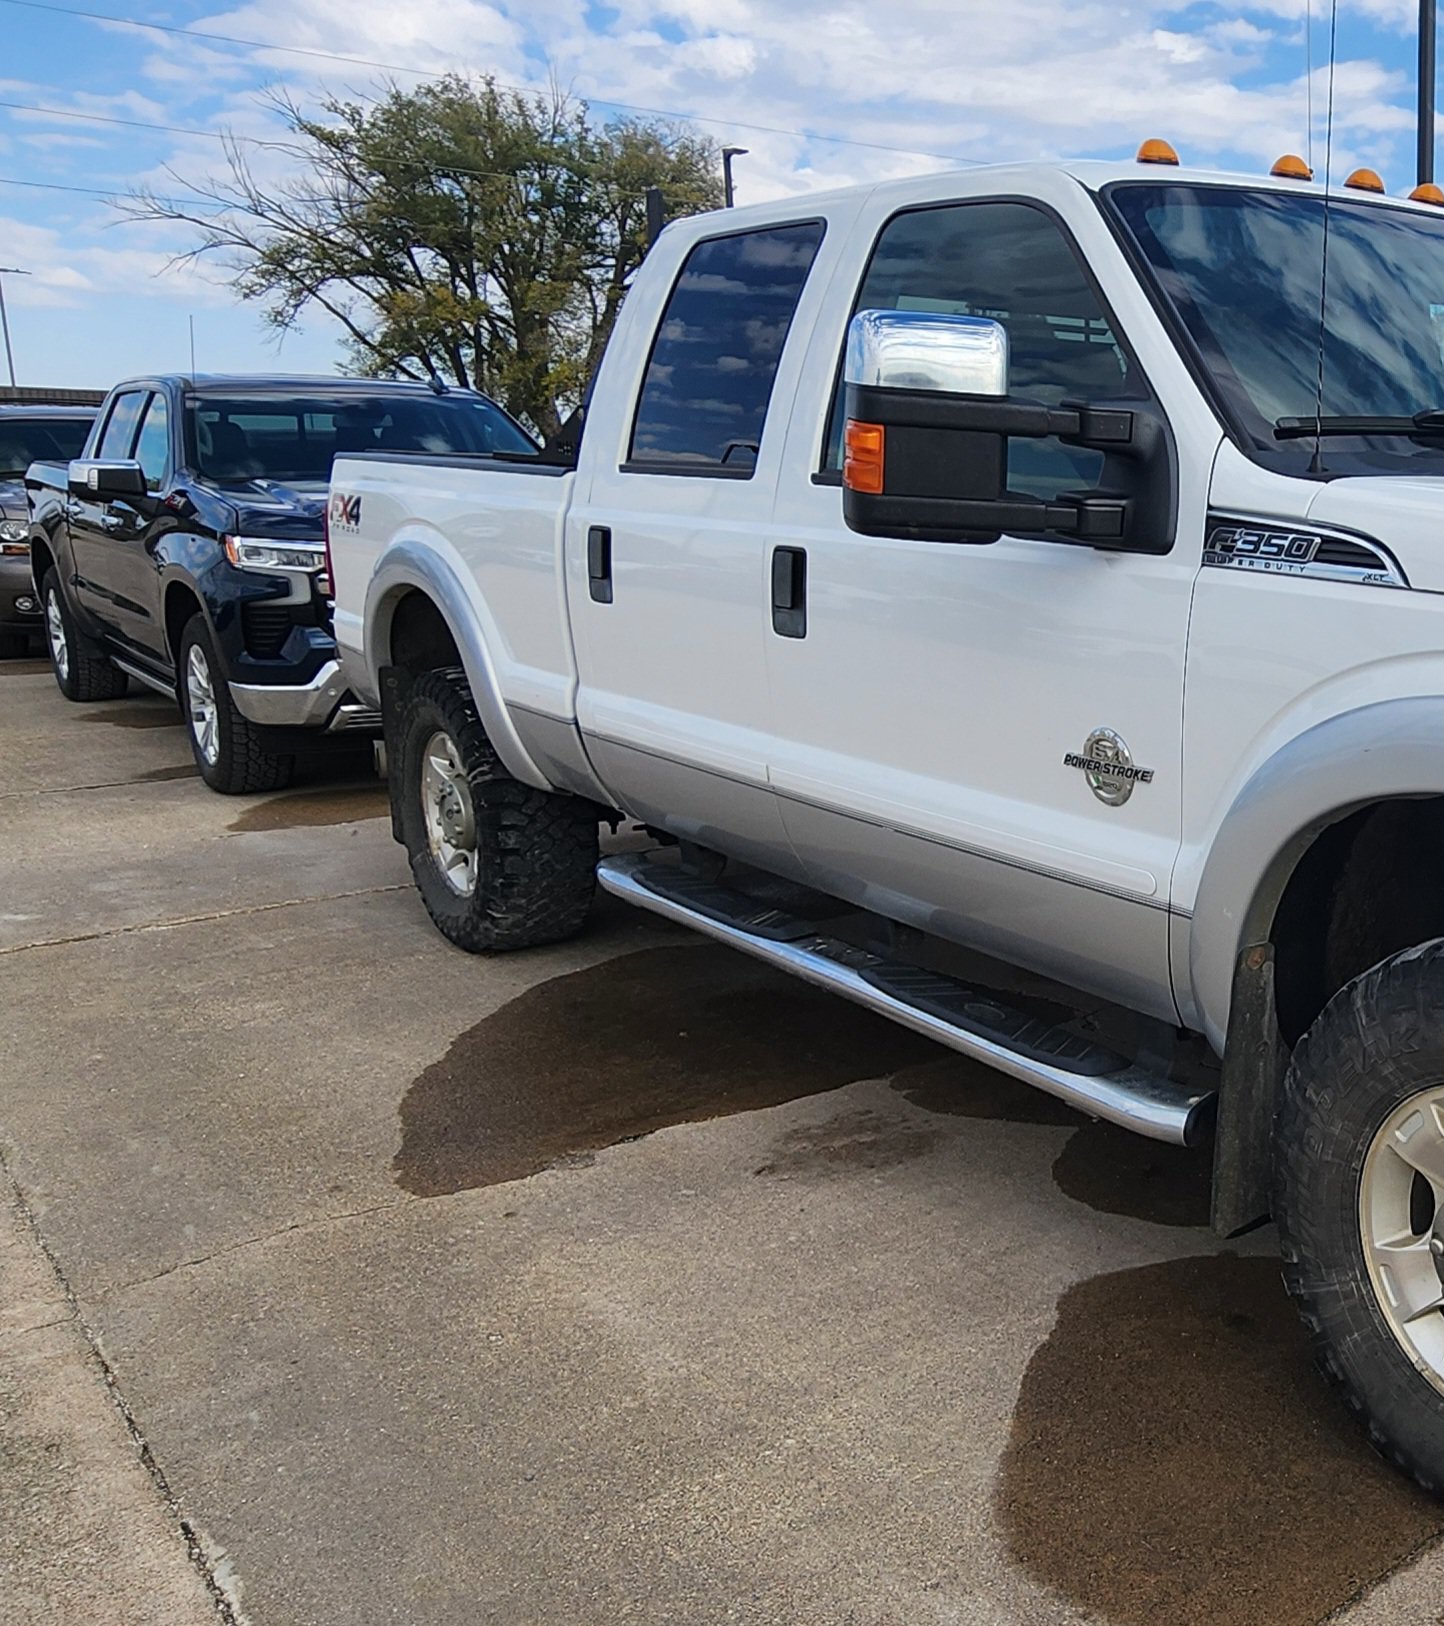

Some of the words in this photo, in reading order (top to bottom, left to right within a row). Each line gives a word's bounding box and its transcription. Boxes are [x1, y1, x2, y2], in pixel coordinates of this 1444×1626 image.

[1204, 553, 1256, 567] SUPER
[1263, 562, 1306, 573] DUTY
[1064, 754, 1101, 772] POWER
[1103, 763, 1151, 782] STROKE
